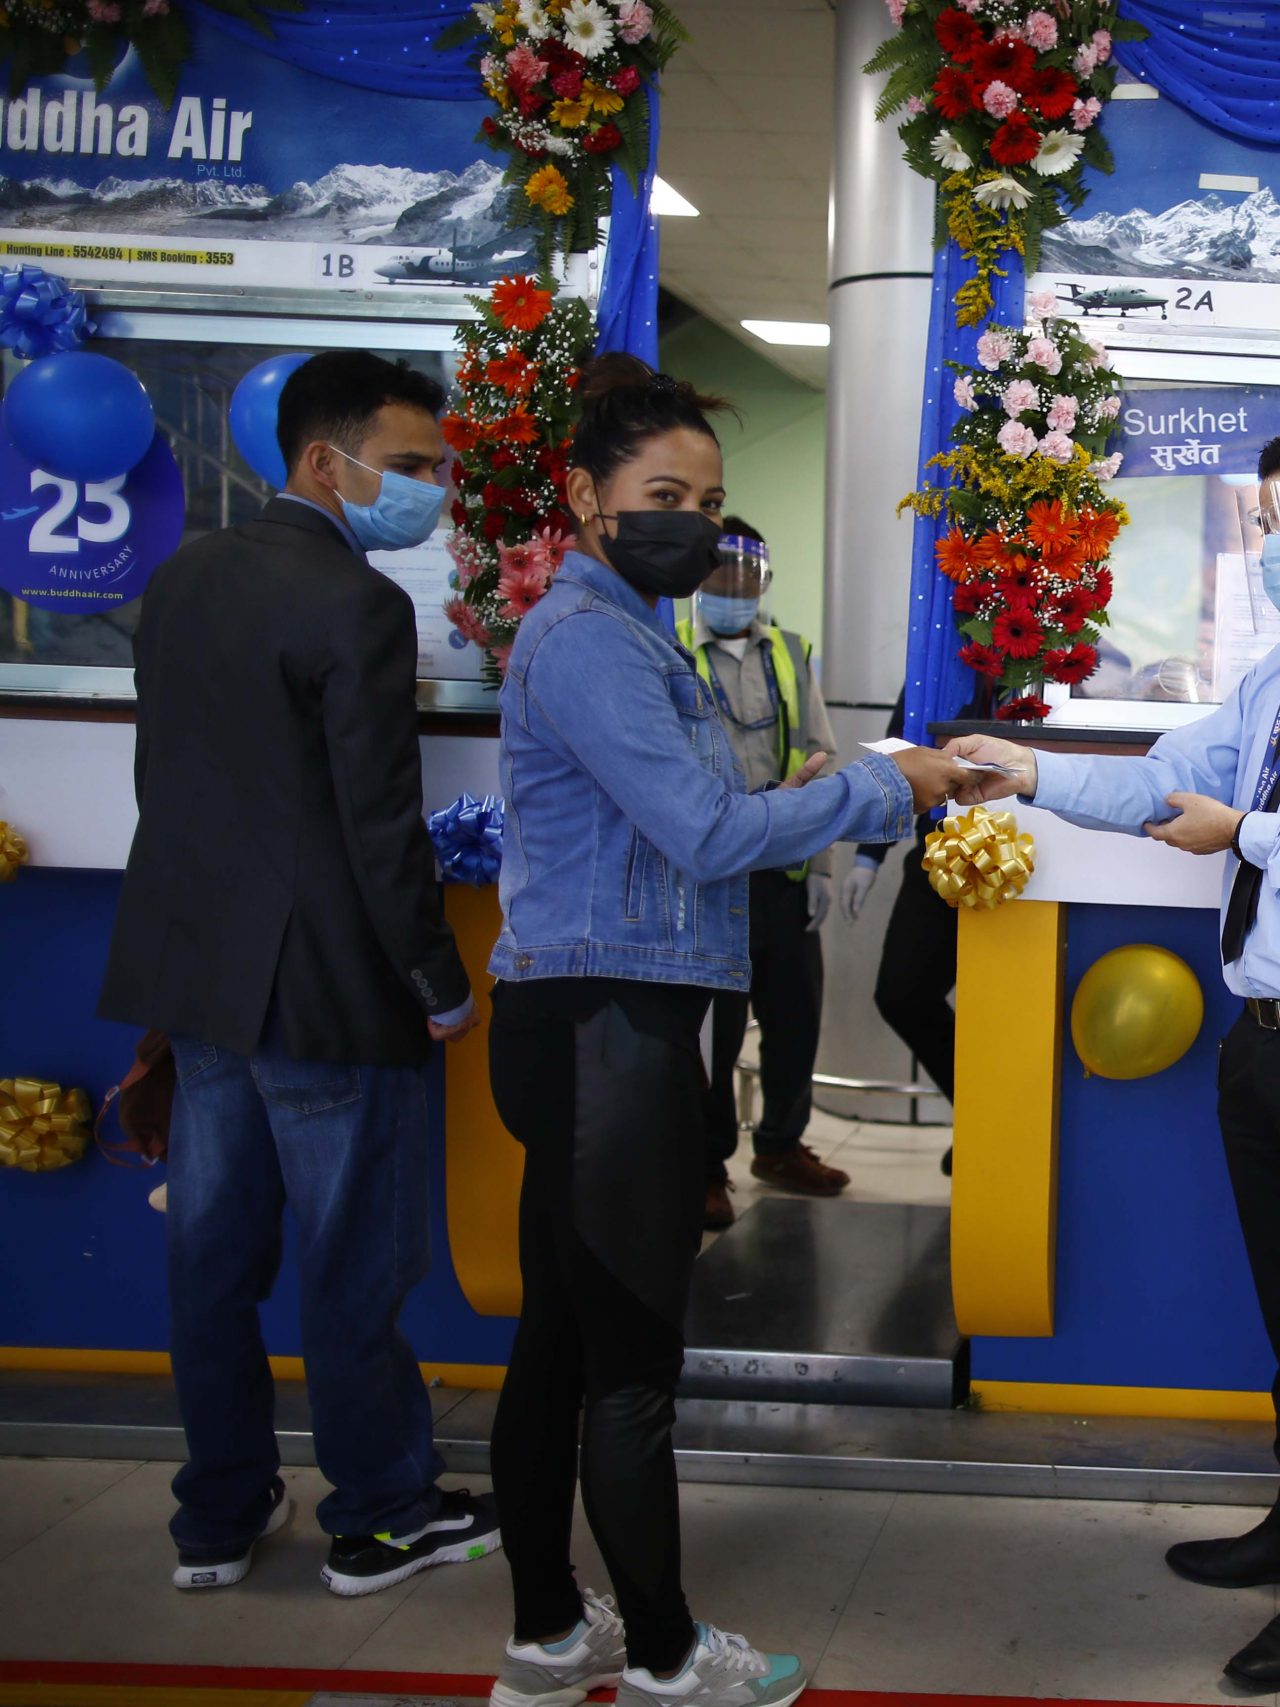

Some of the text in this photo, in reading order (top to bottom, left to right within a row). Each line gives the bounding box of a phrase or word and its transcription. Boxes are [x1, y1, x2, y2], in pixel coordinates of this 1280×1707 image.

[0, 88, 252, 161] ddha Air
[197, 164, 246, 178] Pvt. Ltd.
[6, 244, 42, 257] Hunting
[45, 245, 64, 257] Line
[73, 245, 123, 261] 5542494
[137, 250, 158, 262] SMS
[160, 251, 197, 265] Booking
[205, 251, 234, 265] 3553
[1175, 286, 1214, 312] 2A
[1124, 406, 1249, 436] Surkhet
[1150, 438, 1221, 471] सुर्खेत
[50, 545, 133, 580] ANNIVERSARY
[21, 587, 124, 600] www.buddhaair.com
[1258, 783, 1272, 811] uddha
